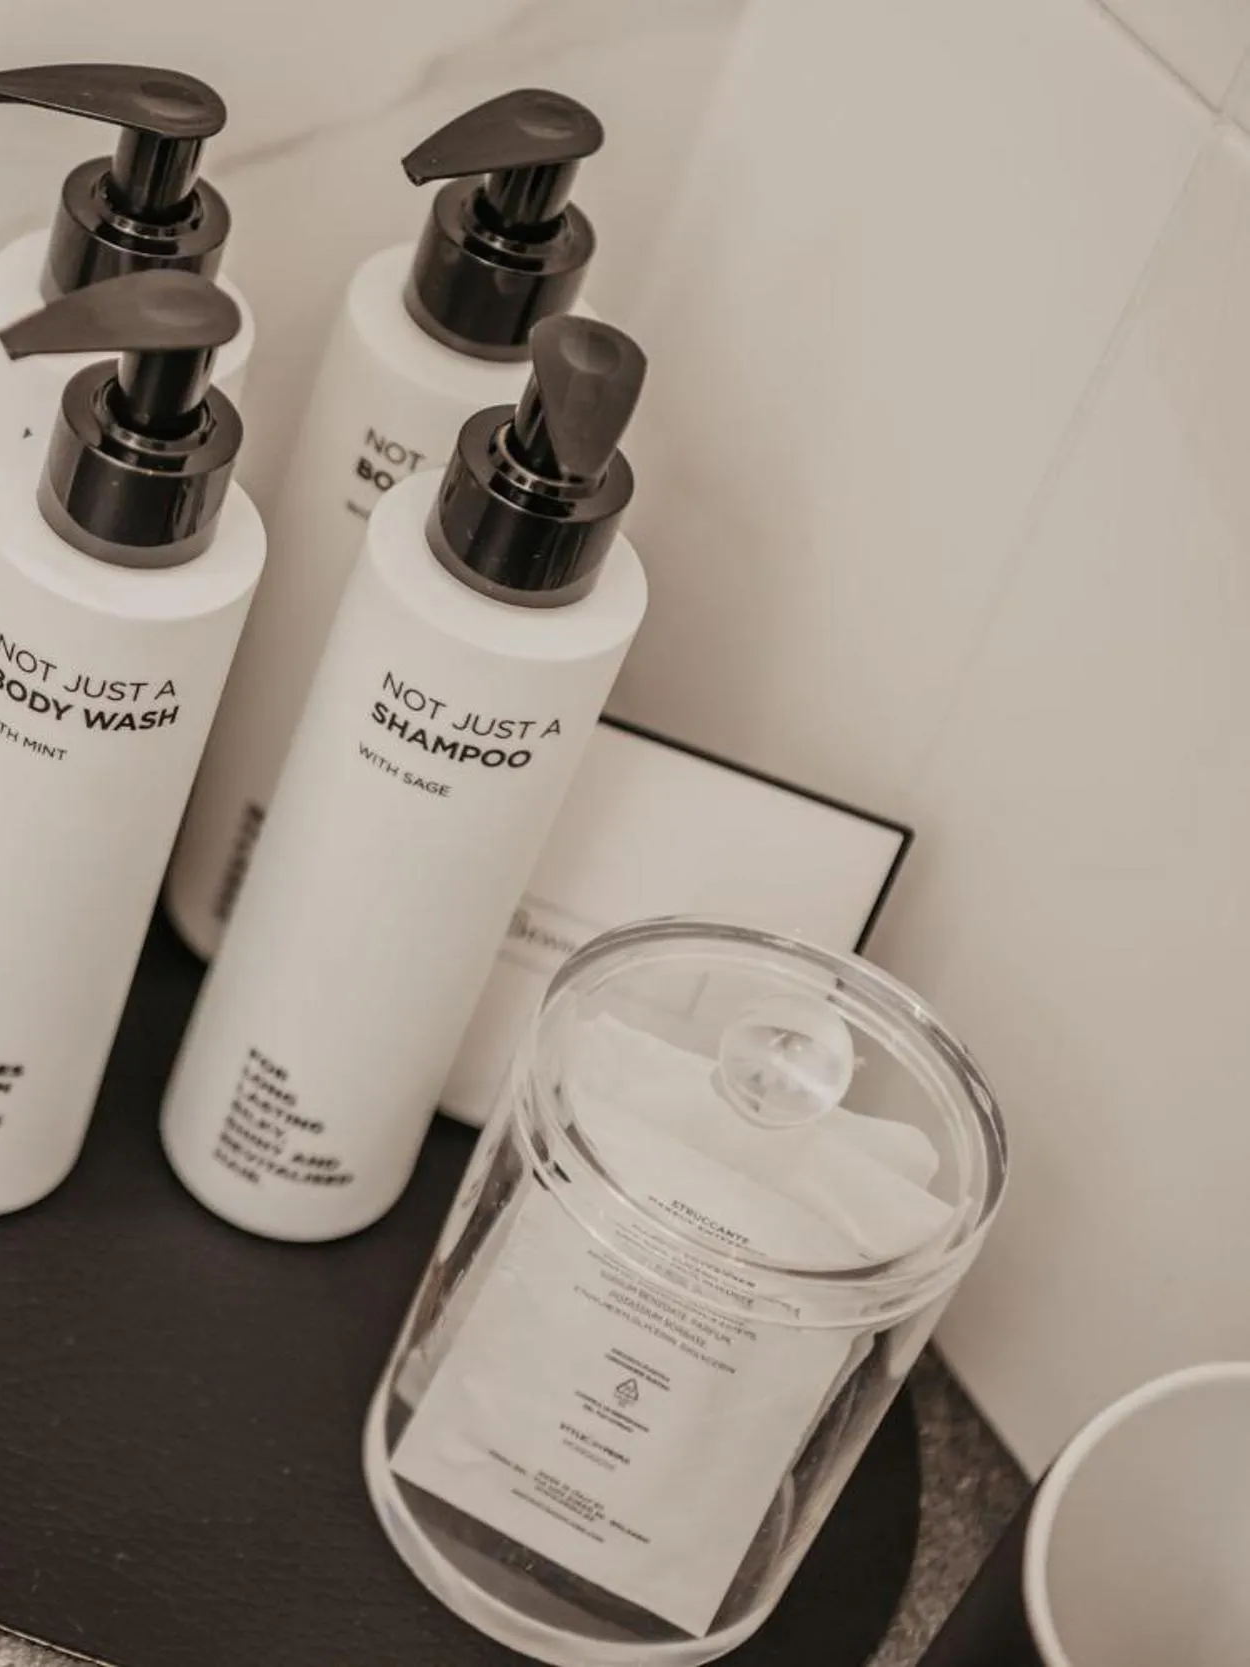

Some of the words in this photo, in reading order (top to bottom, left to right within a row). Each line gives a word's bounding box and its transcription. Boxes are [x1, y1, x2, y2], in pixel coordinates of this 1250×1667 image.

[365, 427, 427, 472] NOT
[356, 457, 395, 492] BO
[63, 674, 148, 702] JUST
[155, 679, 177, 701] A
[382, 671, 447, 720] NOT
[452, 712, 536, 739] JUST
[540, 718, 562, 738] A
[83, 705, 179, 731] WASH
[371, 701, 532, 768] SHAMPOO
[22, 736, 68, 761] MINT
[358, 741, 399, 776] WITH
[402, 772, 452, 798] SAGE
[243, 1065, 297, 1107] LONG
[249, 1048, 288, 1081] FOR
[237, 1082, 325, 1135] LASTING
[225, 1116, 282, 1156] SHINY
[291, 1152, 342, 1172] AND
